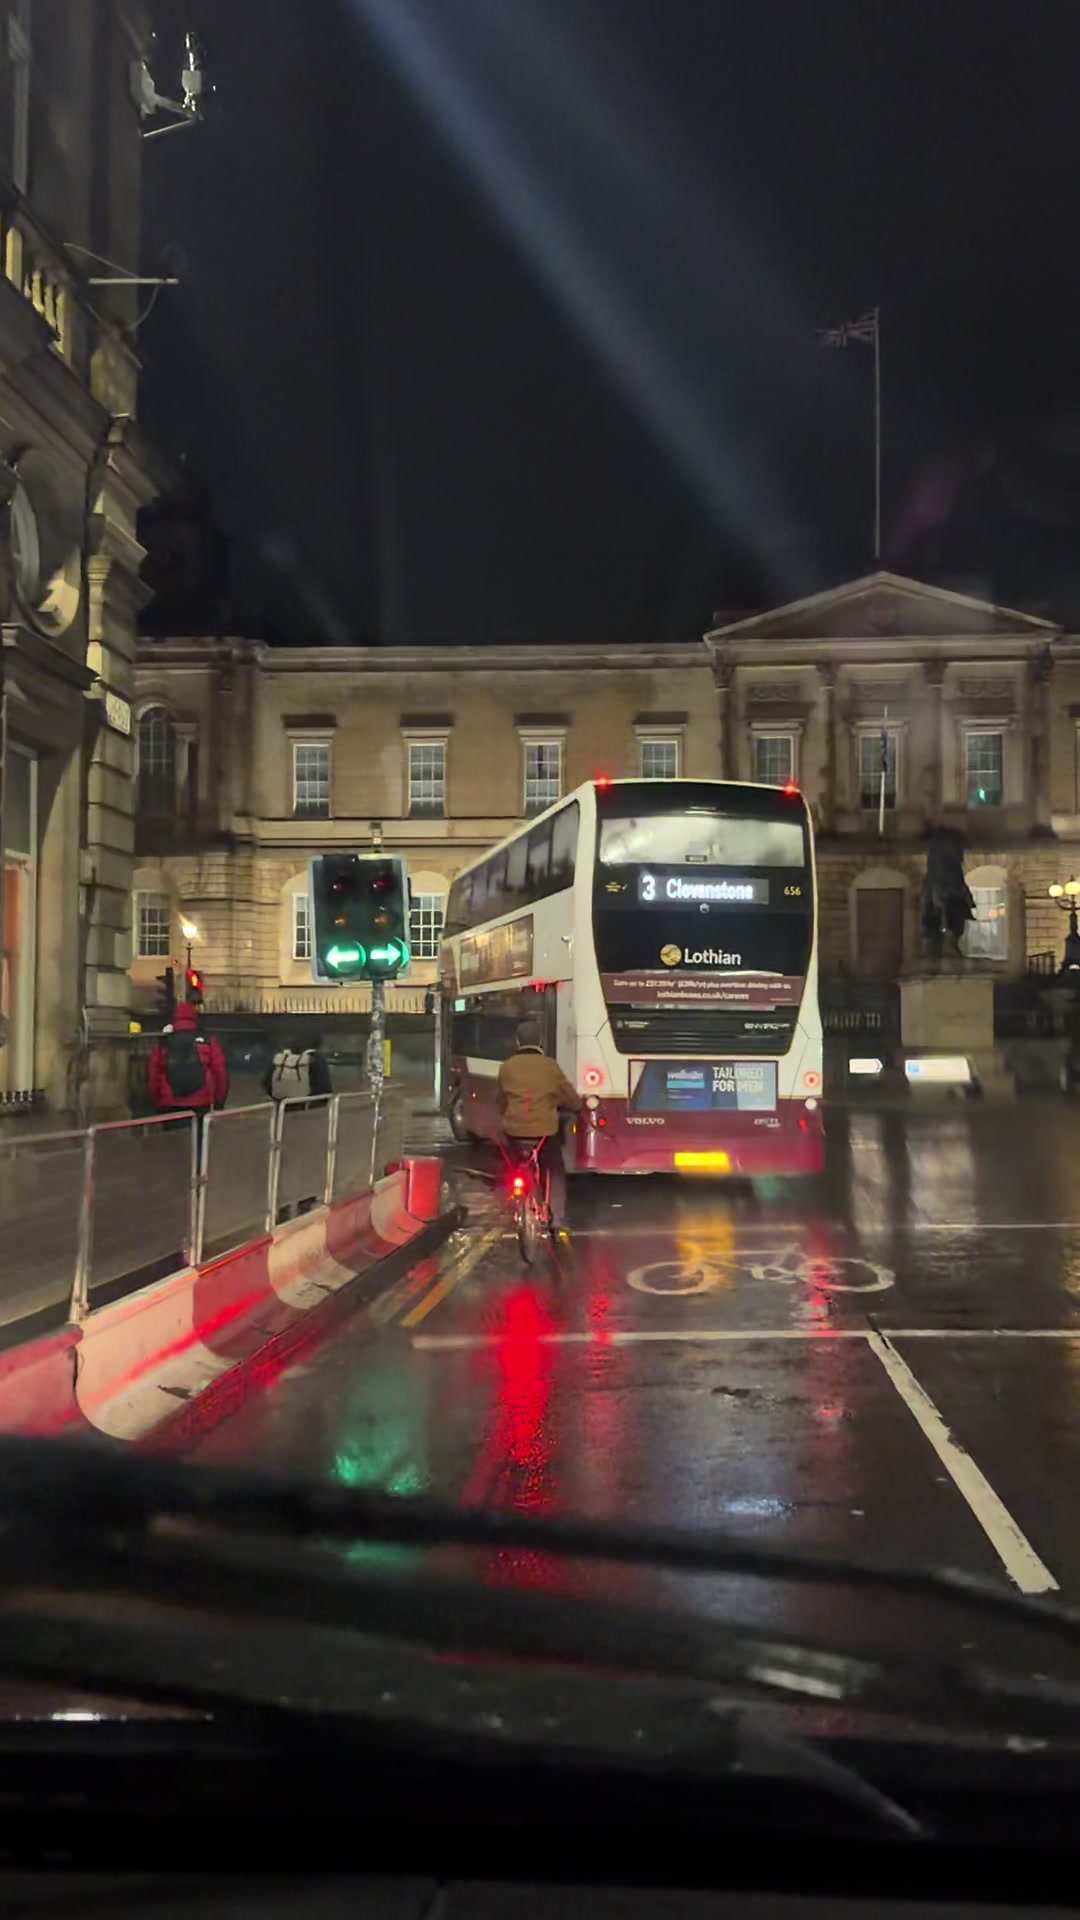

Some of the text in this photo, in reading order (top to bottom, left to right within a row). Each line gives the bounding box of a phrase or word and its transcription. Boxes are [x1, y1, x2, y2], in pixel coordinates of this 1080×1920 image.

[642, 876, 656, 901] 3
[784, 886, 801, 896] 656
[684, 948, 741, 965] Lothian
[712, 1066, 764, 1080] TAILORED
[712, 1080, 763, 1094] FOR MEN
[625, 1117, 665, 1125] VOLVO
